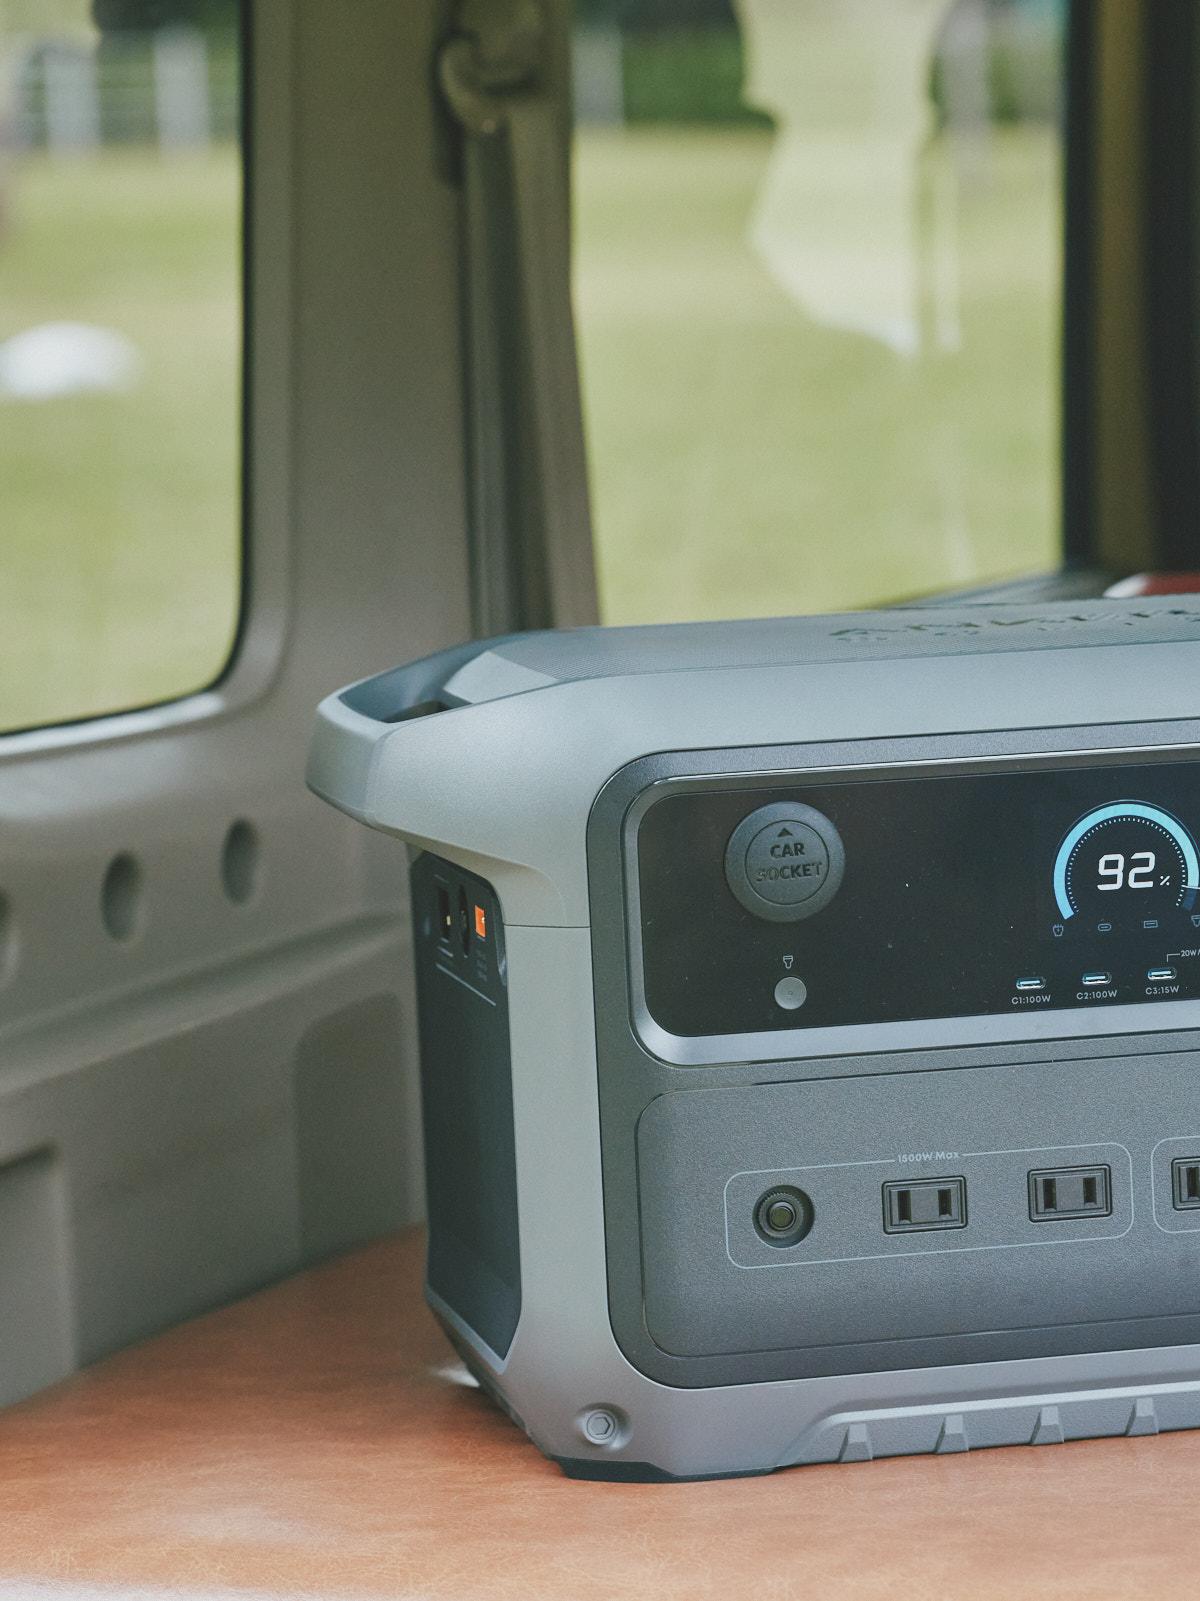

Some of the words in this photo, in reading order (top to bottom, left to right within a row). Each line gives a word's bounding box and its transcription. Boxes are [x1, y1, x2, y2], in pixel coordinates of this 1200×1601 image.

[770, 842, 805, 858] CAR
[756, 862, 823, 881] SOCKET
[1180, 949, 1197, 957] 20W
[1076, 990, 1118, 1000] C2:100W
[1145, 985, 1180, 995] C3:15W
[1011, 994, 1051, 1005] C1:100W
[897, 1152, 933, 1163] 1500W
[935, 1151, 960, 1161] Max
